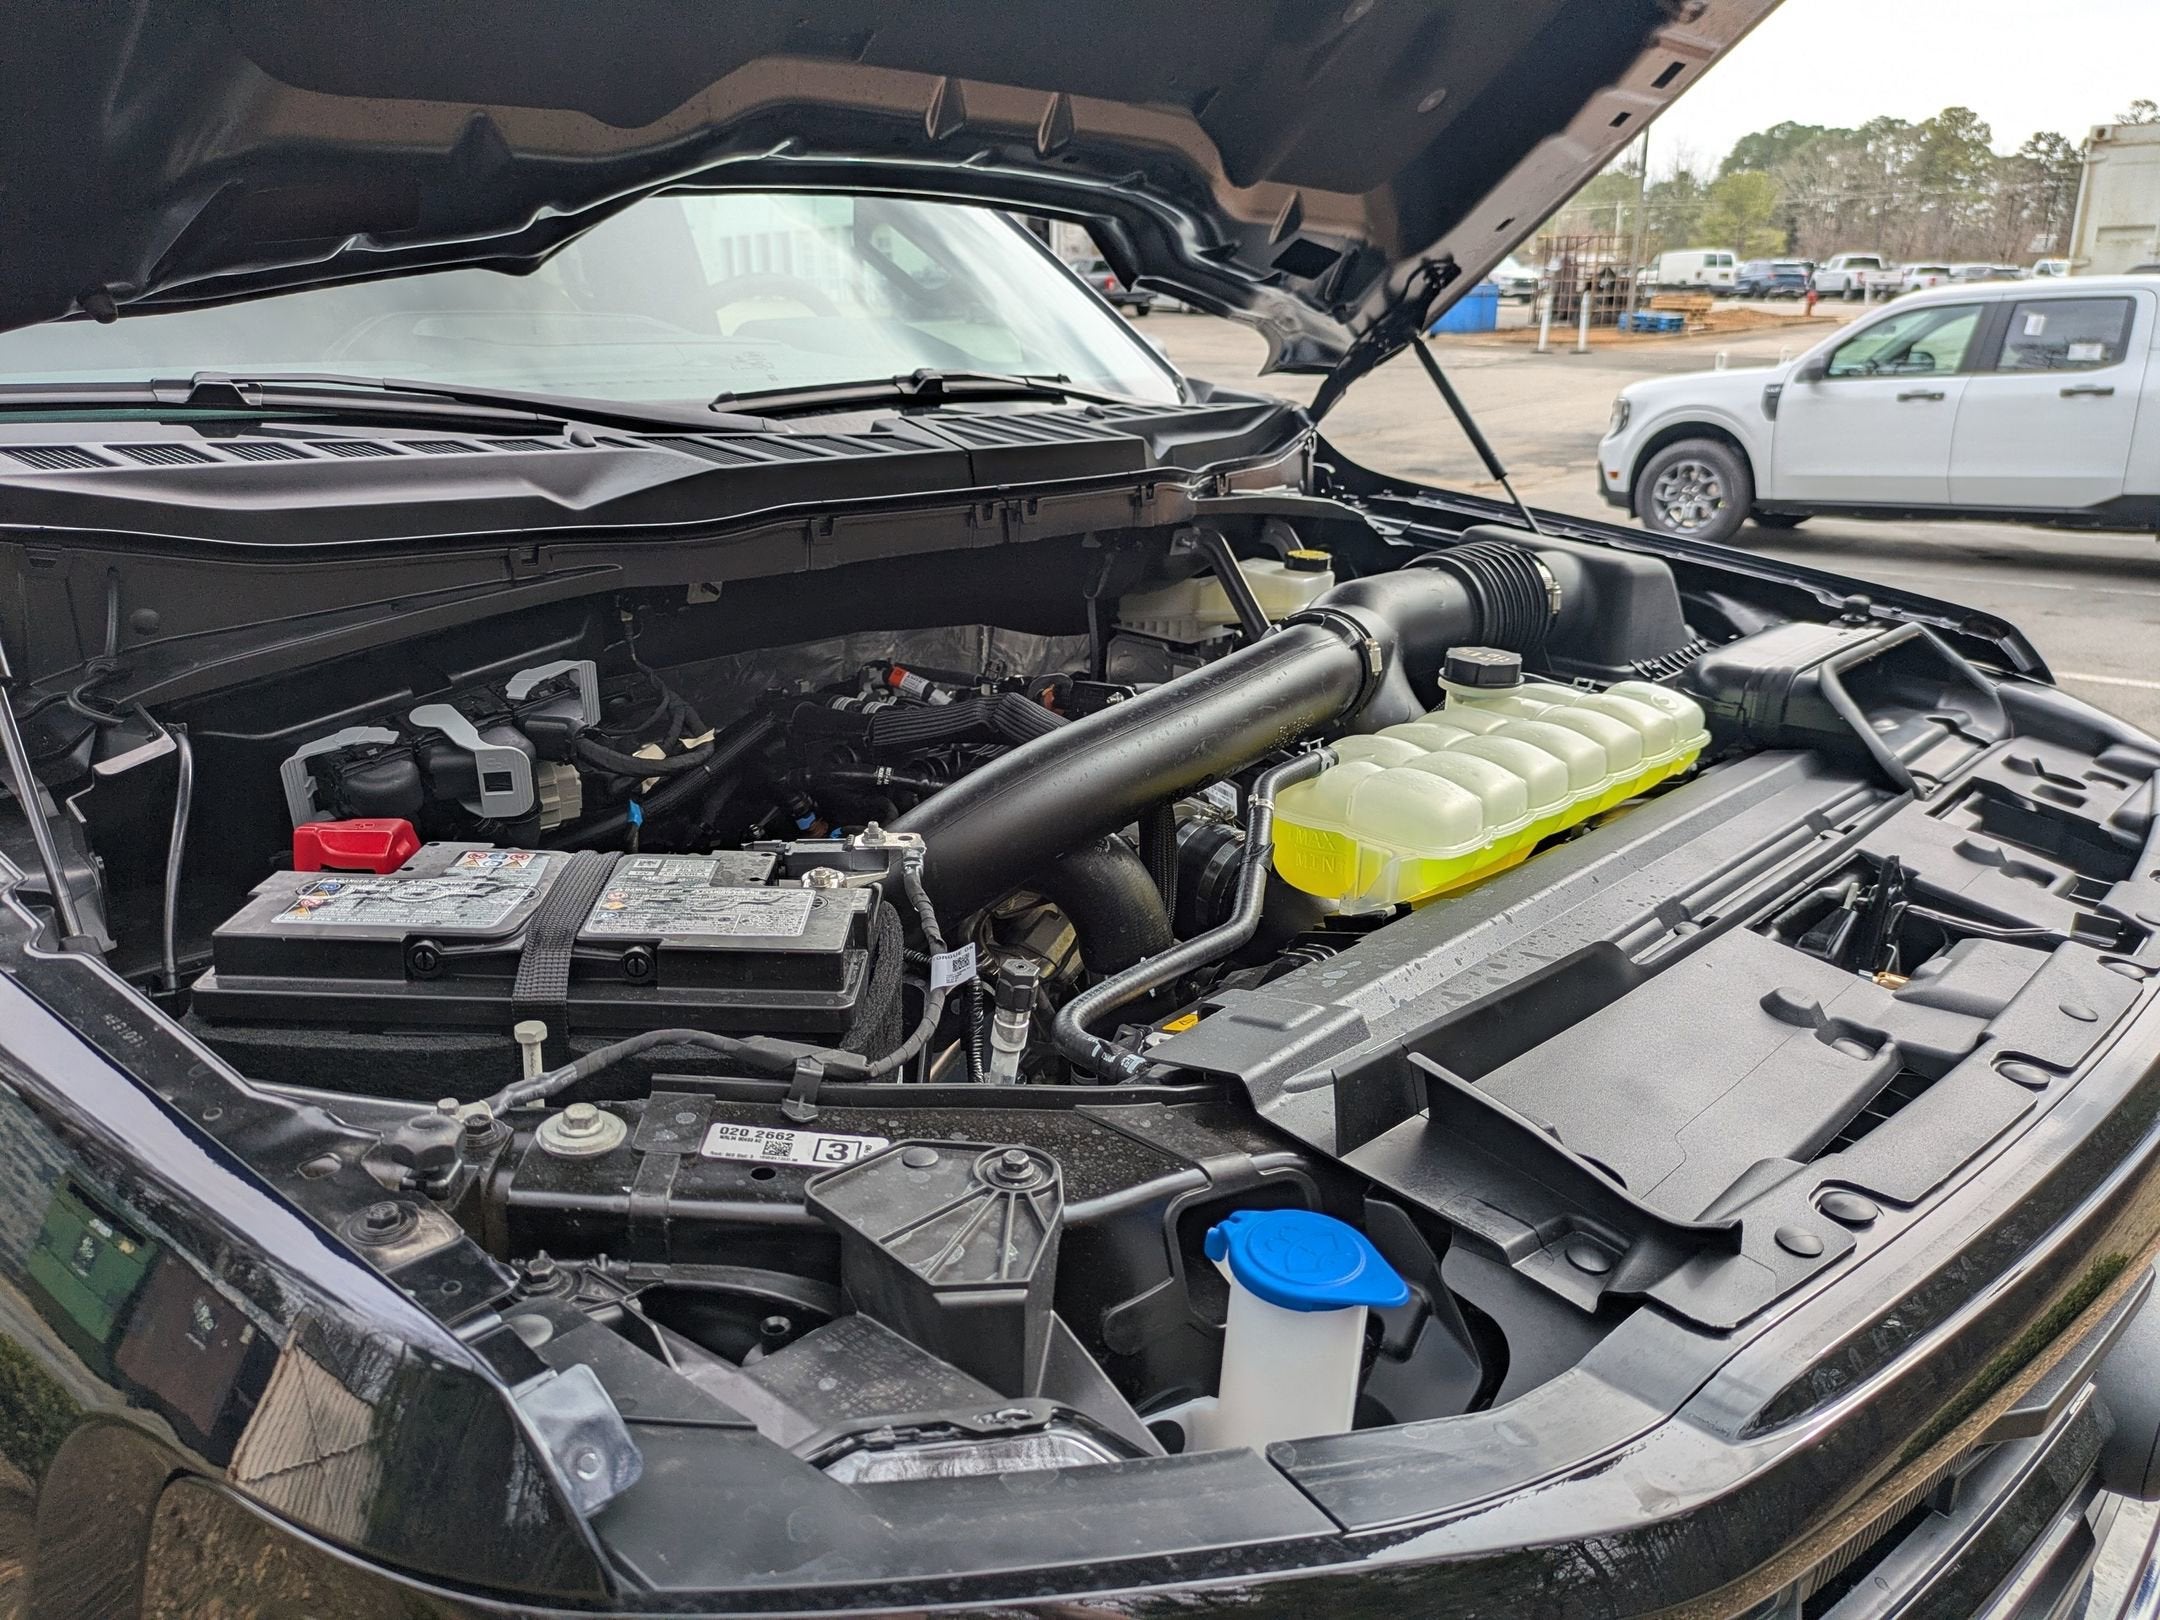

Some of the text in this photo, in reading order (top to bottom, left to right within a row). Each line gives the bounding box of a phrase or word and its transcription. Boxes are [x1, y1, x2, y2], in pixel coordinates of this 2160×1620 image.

[1295, 827, 1337, 850] MAX
[1296, 852, 1336, 873] MIN
[719, 1126, 750, 1137] 020
[754, 1130, 795, 1141] 2662
[825, 1142, 849, 1161] 3
